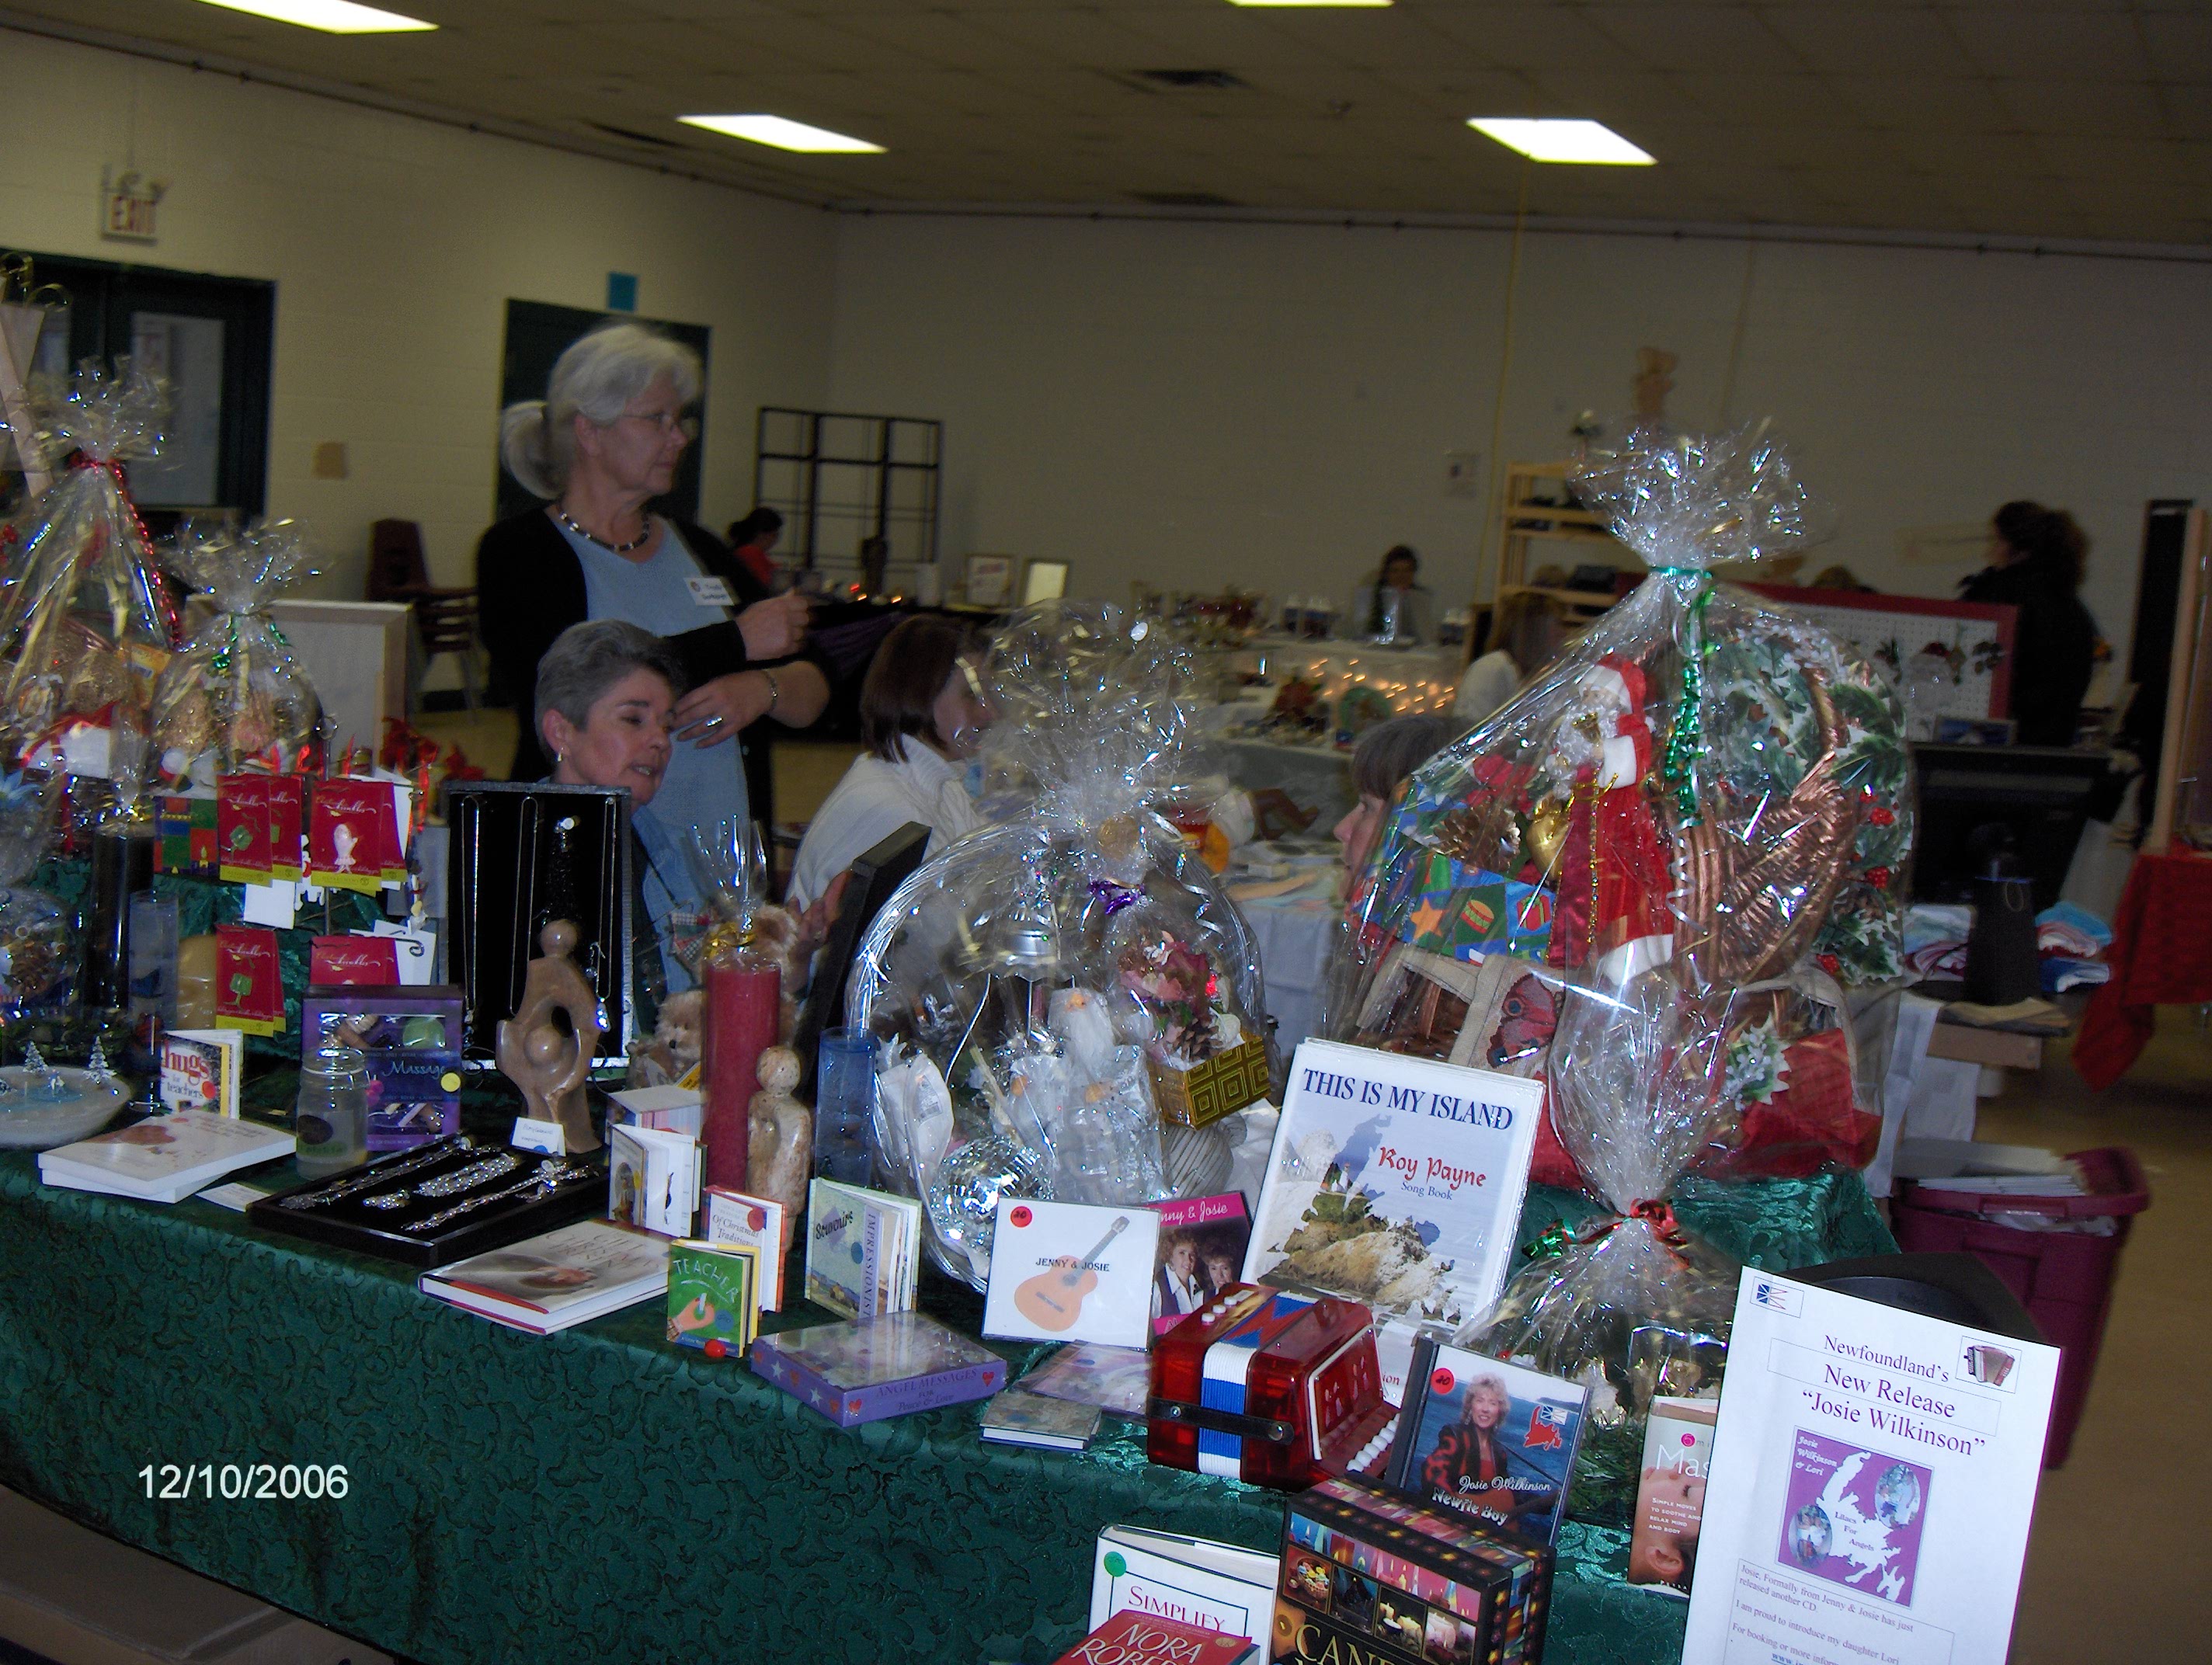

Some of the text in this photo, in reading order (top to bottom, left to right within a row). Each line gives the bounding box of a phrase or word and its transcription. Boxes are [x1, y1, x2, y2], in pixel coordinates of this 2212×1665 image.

[161, 1038, 210, 1086] hugs
[382, 1059, 447, 1080] Massage
[1303, 1068, 1513, 1131] THIS IS MY ISLAND
[1378, 1146, 1487, 1191] Roy Payne
[1401, 1181, 1453, 1201] Song Book
[1199, 1201, 1228, 1222] Josie
[723, 1218, 760, 1239] Christmas
[1035, 1257, 1110, 1273] JENNY & JOSIE
[673, 1258, 739, 1304] TEACHER
[1823, 1334, 1949, 1382] Newfoundland's
[877, 1368, 977, 1396] ANGEL MESSAGES
[1824, 1364, 1955, 1418] New Release
[1797, 1436, 1818, 1448] Josie
[1797, 1448, 1838, 1467] Wilkinson
[1459, 1475, 1552, 1495] Josie Wilkinson
[1480, 1503, 1508, 1526] Boy
[1649, 1515, 1669, 1524] RELAX
[1661, 1509, 1686, 1518] SOOTHE
[1835, 1510, 1857, 1524] Lilacs
[1844, 1524, 1858, 1535] For
[1849, 1538, 1874, 1552] Angels
[1739, 1577, 1770, 1595] released
[1771, 1590, 1801, 1606] another
[1763, 1573, 1798, 1594] Formally
[1800, 1587, 1820, 1601] from
[1821, 1594, 1846, 1611] Jenny
[1847, 1604, 1856, 1614] &
[1858, 1607, 1880, 1622] Josie
[1881, 1615, 1897, 1627] has
[1896, 1620, 1914, 1633] just
[1129, 1585, 1226, 1632] SIMPLIFY
[1732, 1622, 1746, 1635] For
[1747, 1628, 1778, 1649] booking
[1779, 1642, 1789, 1651] or
[1789, 1646, 1811, 1660] more
[1735, 1599, 1900, 1665] I am proud to introduce my daughter Lori
[1113, 1623, 1203, 1665] NORA
